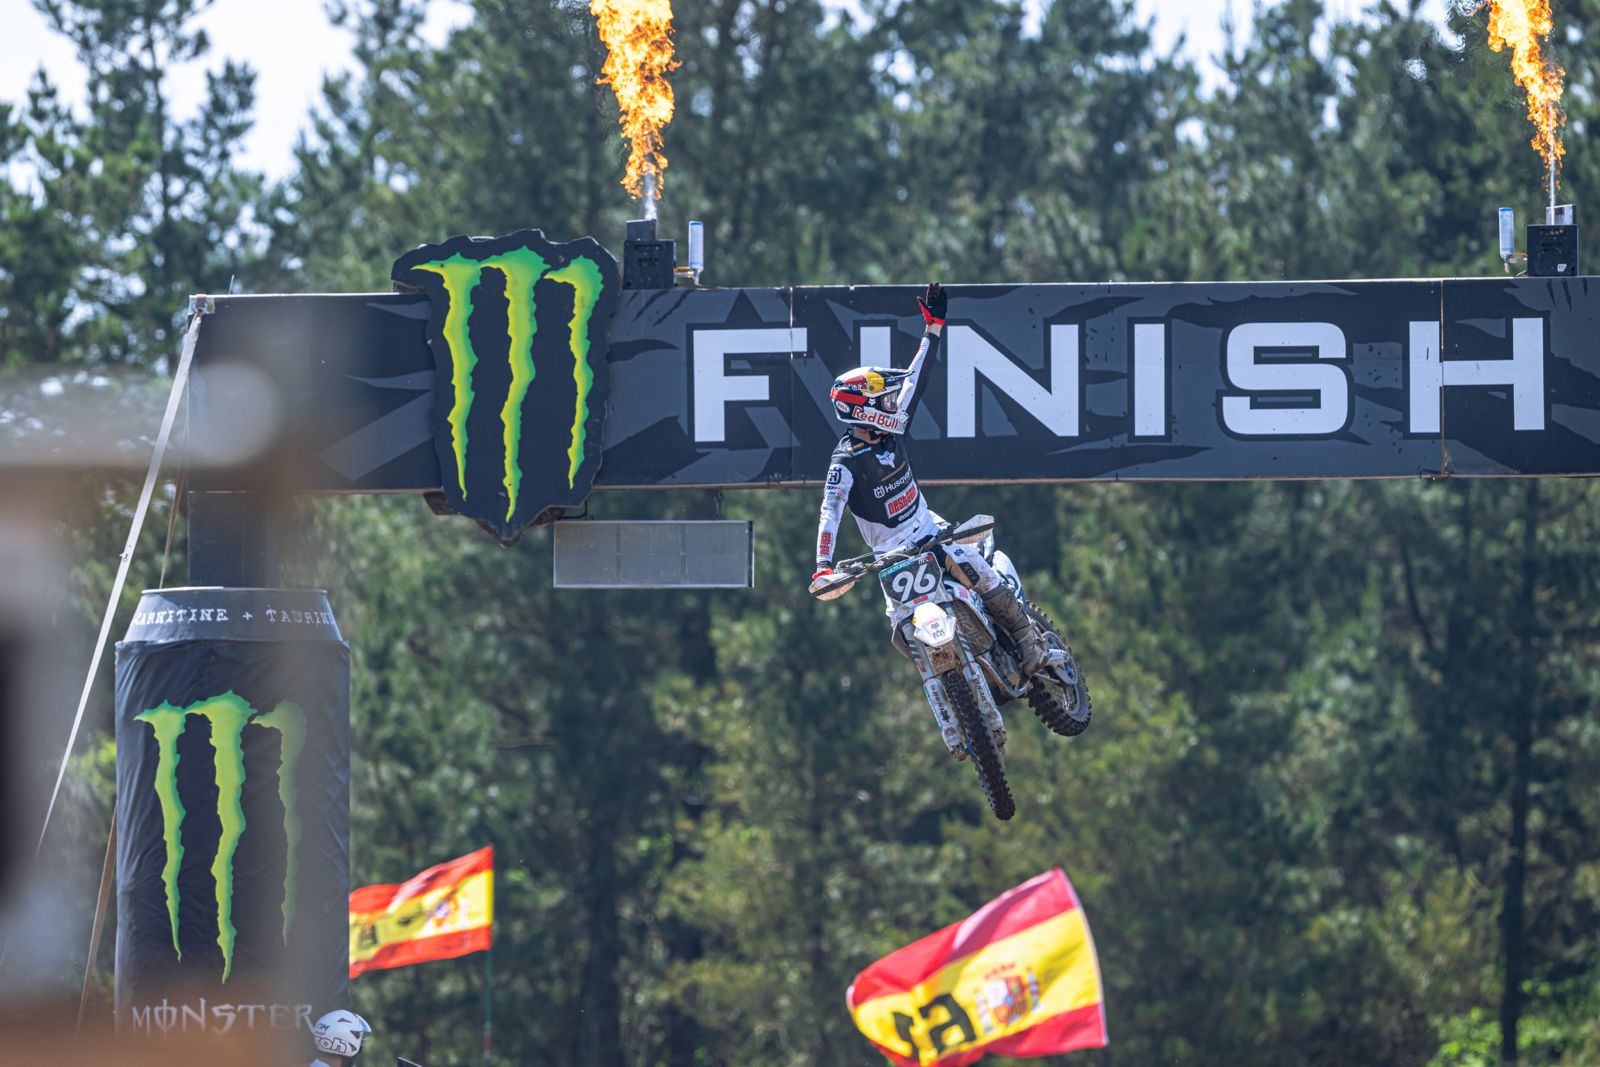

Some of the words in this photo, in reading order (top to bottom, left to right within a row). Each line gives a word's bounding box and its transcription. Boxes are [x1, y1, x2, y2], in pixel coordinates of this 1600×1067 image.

[851, 405, 877, 423] Red
[878, 413, 899, 429] Bull
[892, 563, 936, 603] 96
[242, 612, 253, 621] +
[132, 998, 314, 1039] MONSTER
